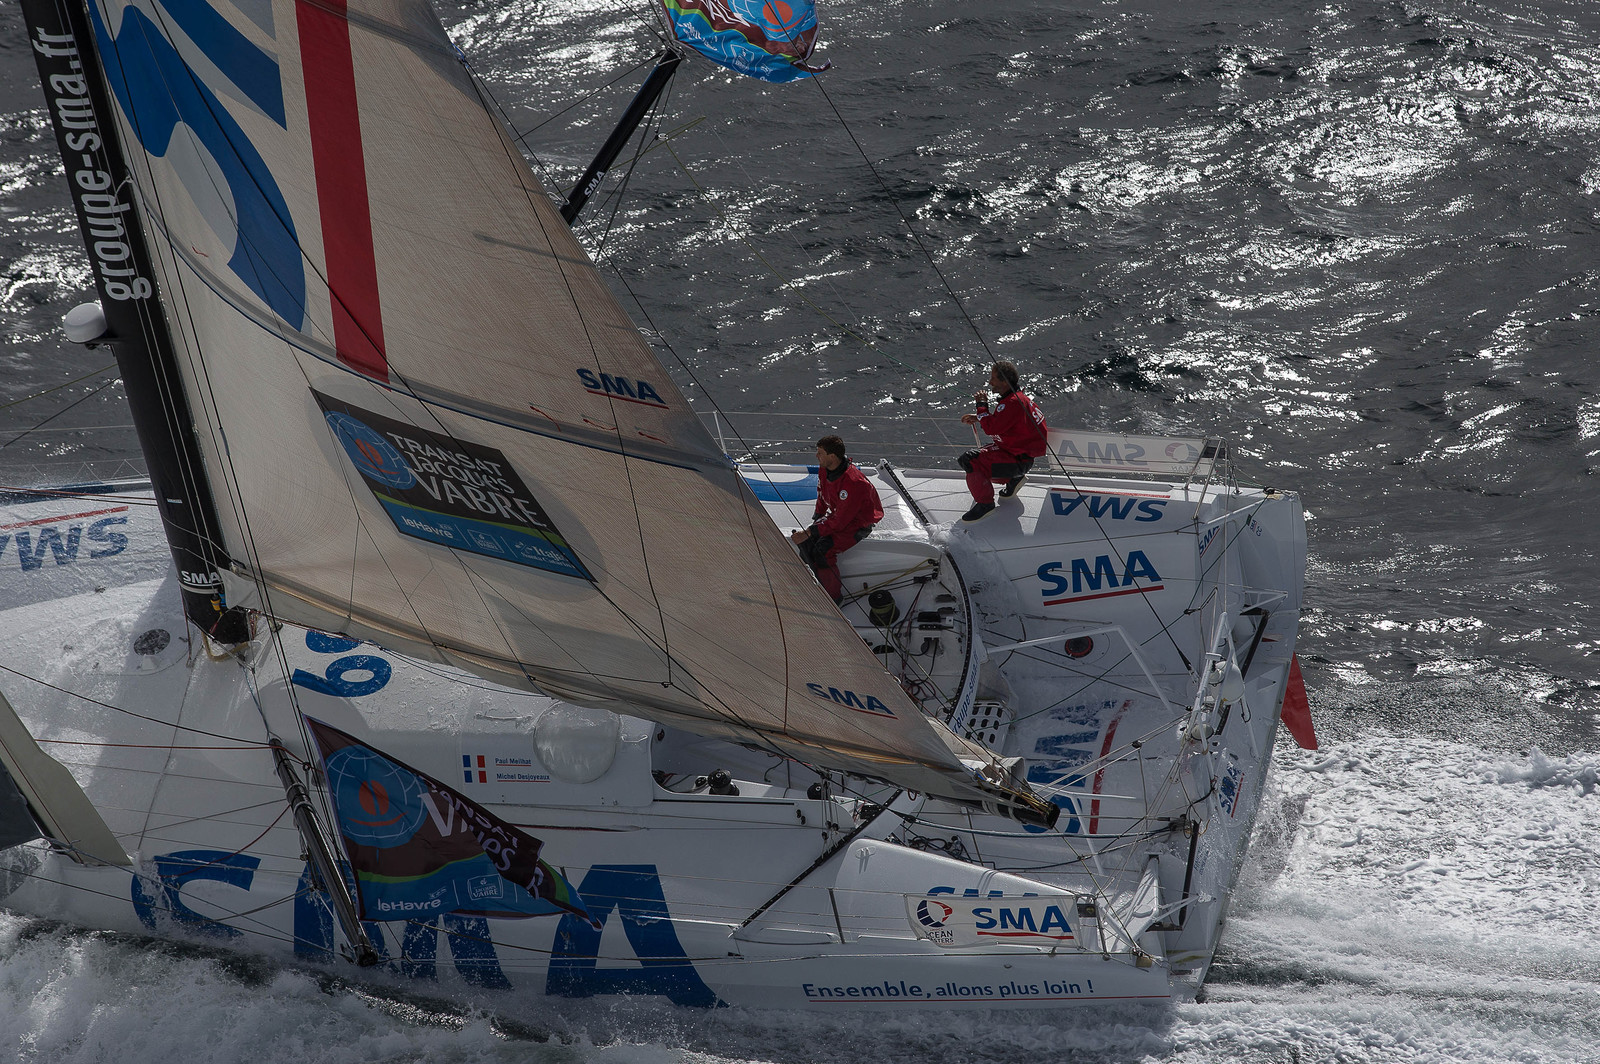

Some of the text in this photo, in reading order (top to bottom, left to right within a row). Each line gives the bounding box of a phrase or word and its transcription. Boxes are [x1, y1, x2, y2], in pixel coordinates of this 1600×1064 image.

[32, 26, 152, 301] groupe-sma.fr
[584, 170, 605, 198] SMA
[576, 368, 667, 405] SMA
[386, 432, 501, 476] TRANSAT
[404, 465, 547, 527] VABRE
[1050, 493, 1168, 521] SMA
[400, 516, 454, 539] leHavre
[181, 571, 222, 584] SMA
[1037, 550, 1163, 597] SMA
[806, 683, 895, 715] SMA
[377, 897, 442, 912] leHavre
[971, 905, 1073, 933] SMA
[802, 979, 1094, 998] Ensemble, allons plus loin !
